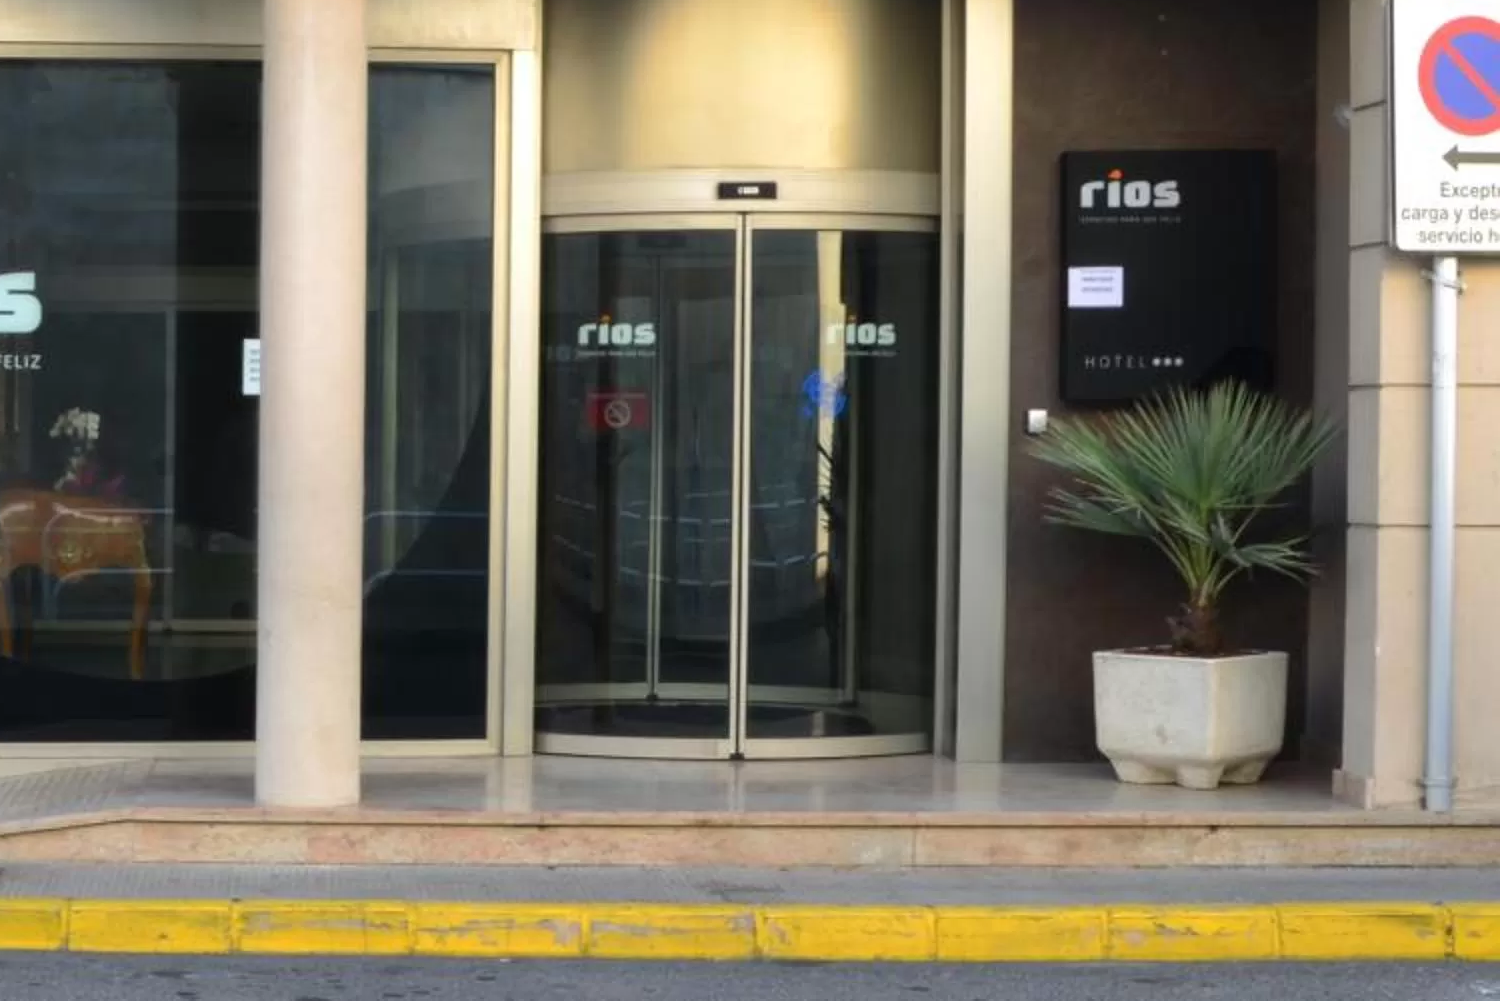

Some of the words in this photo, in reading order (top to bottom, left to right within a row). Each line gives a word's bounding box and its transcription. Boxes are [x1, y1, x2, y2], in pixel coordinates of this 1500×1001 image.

[1080, 169, 1181, 208] rios
[1440, 181, 1500, 200] Except
[1401, 207, 1449, 223] carga
[1453, 207, 1462, 224] y
[1417, 226, 1483, 244] servicio
[577, 314, 656, 346] rios
[1084, 354, 1147, 369] HOTEL
